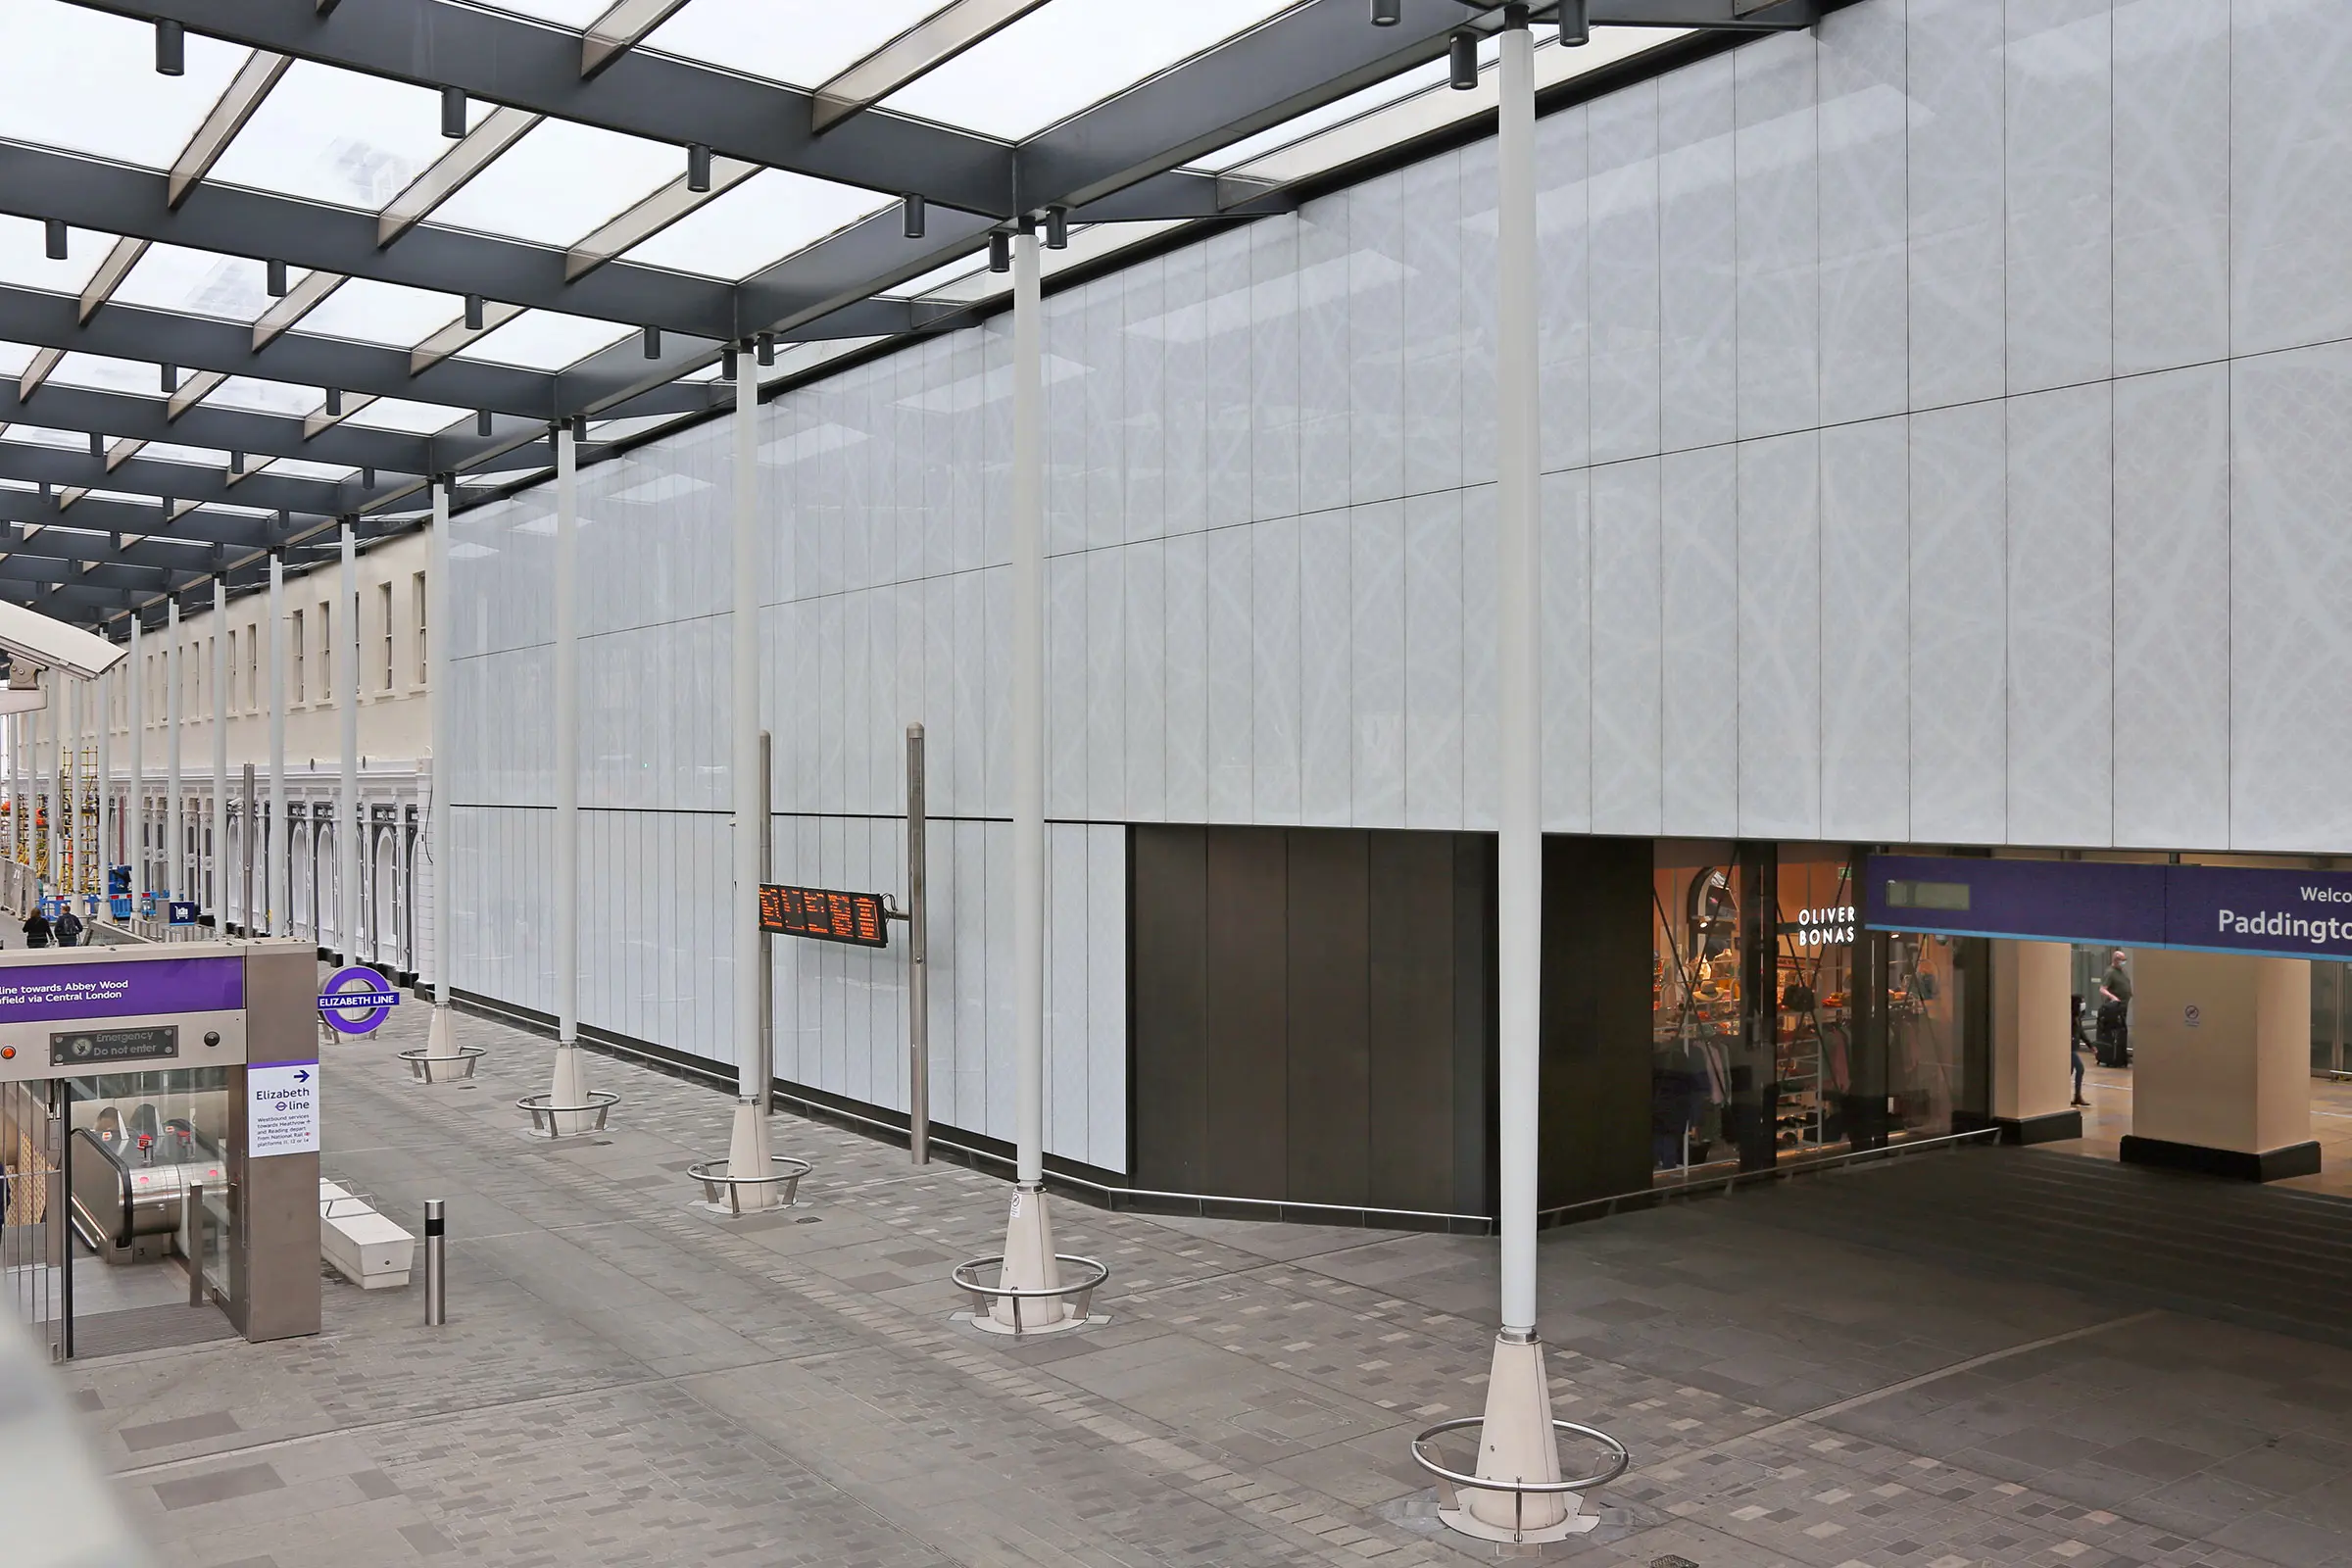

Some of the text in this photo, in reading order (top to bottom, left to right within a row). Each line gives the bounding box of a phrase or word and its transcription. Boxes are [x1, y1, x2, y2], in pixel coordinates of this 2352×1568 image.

[2300, 886, 2352, 903] Welco
[1798, 906, 1855, 926] OLIVER
[1799, 925, 1854, 947] BONAS
[21, 984, 62, 994] towards
[65, 982, 96, 992] Abbey
[99, 980, 128, 989] Wood
[28, 995, 42, 1004] via
[45, 992, 82, 1003] Central
[85, 990, 122, 1001] London
[319, 995, 394, 1006] ELIZABETH LINE
[96, 1031, 154, 1044] Emergency
[93, 1043, 157, 1056] Do not enter
[256, 1087, 310, 1101] Elizabeth
[288, 1101, 310, 1110] line
[257, 1140, 282, 1149] platforms
